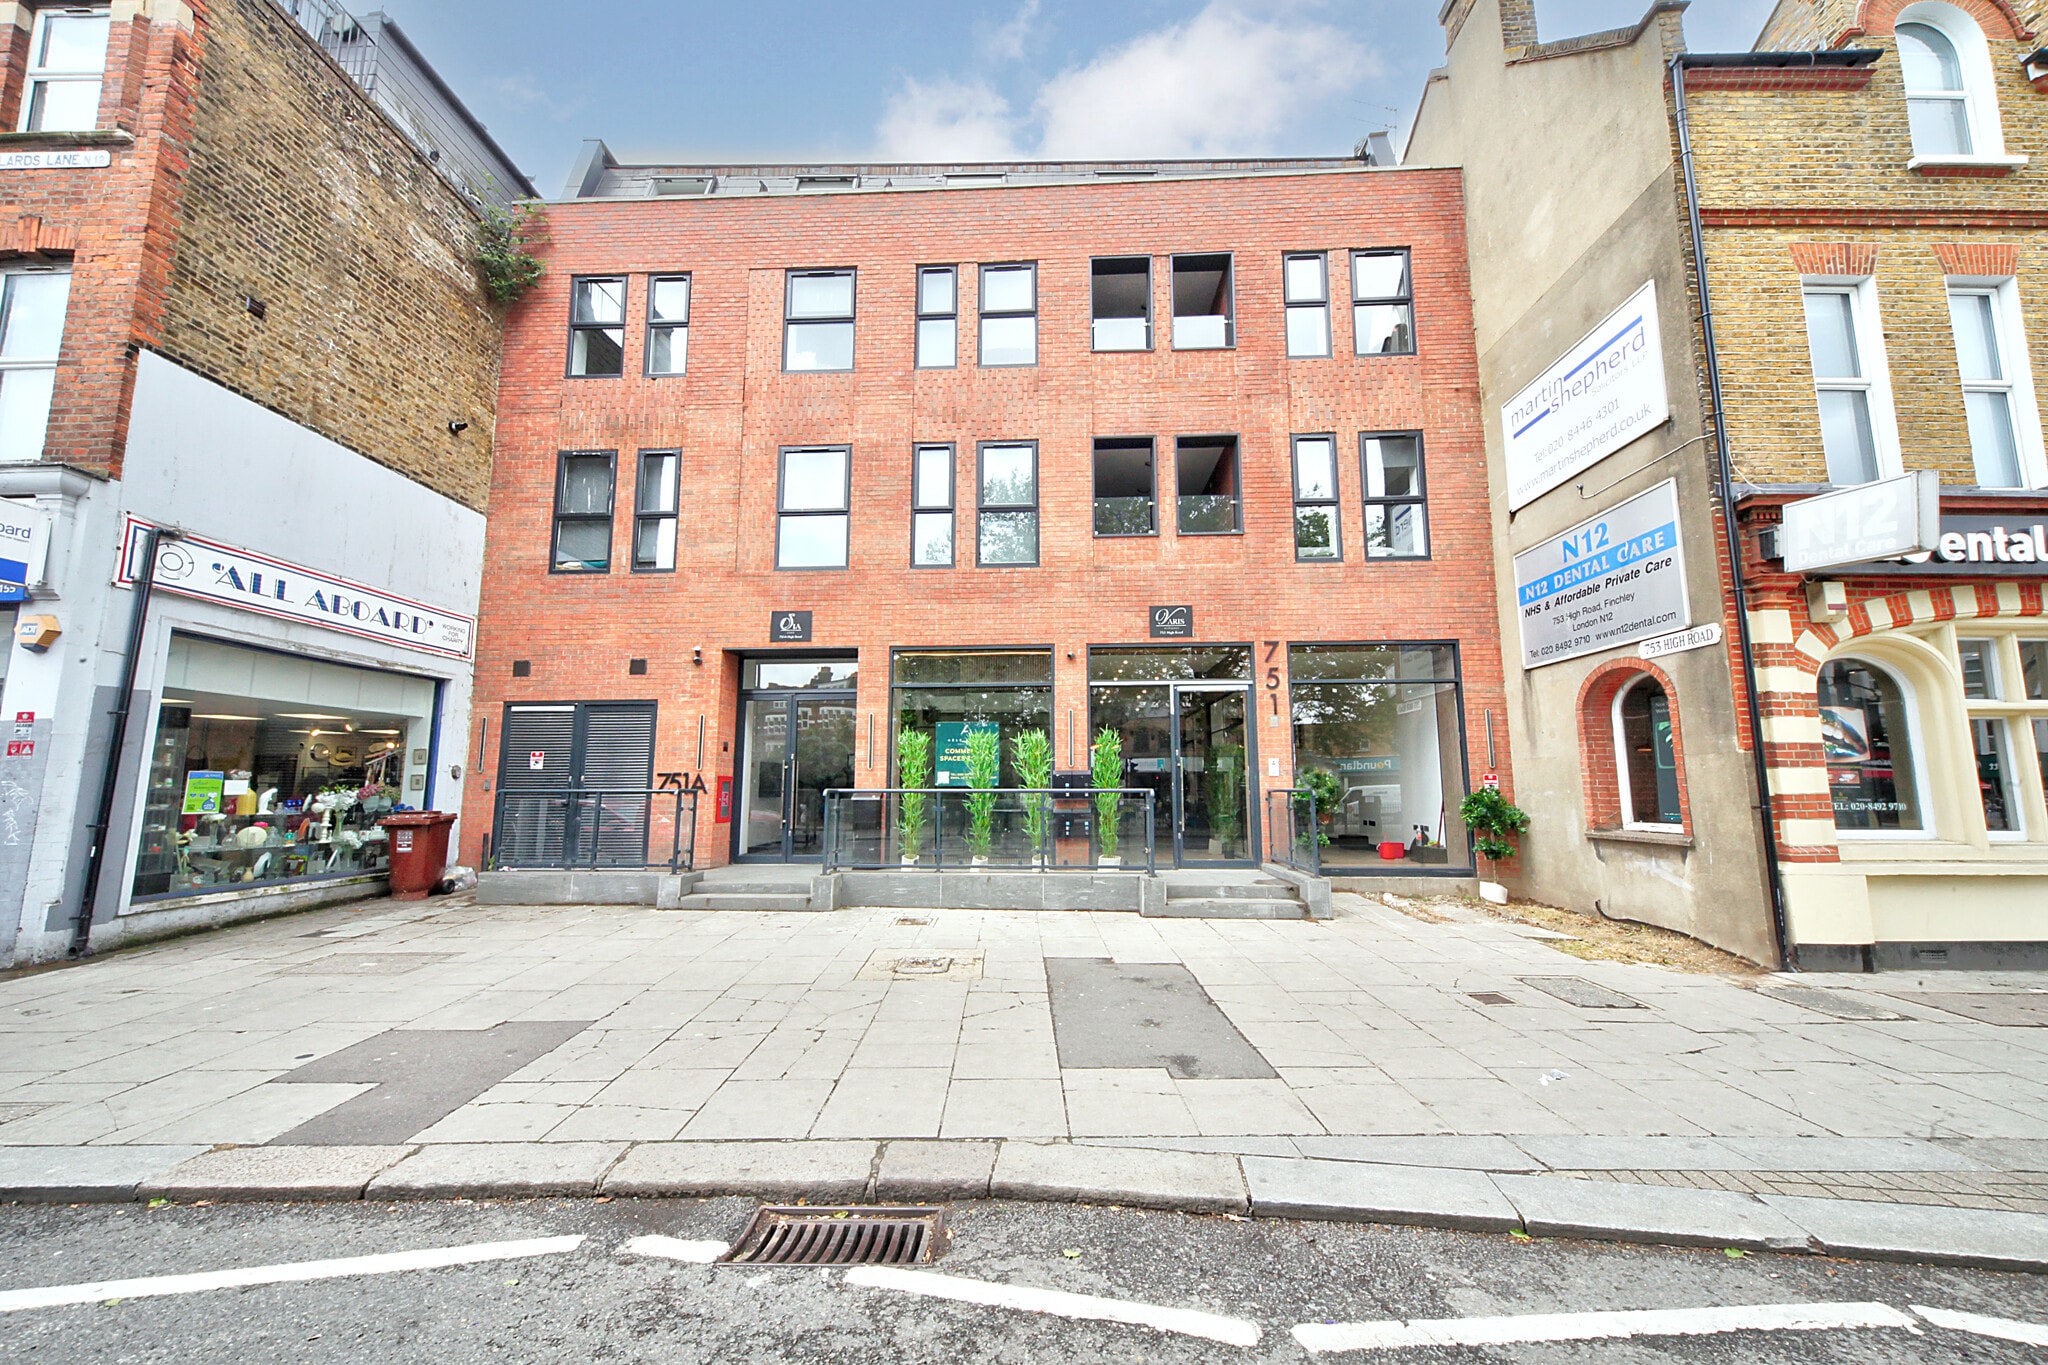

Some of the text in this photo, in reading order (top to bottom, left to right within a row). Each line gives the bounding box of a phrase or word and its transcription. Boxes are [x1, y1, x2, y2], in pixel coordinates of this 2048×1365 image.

[46, 154, 80, 166] LANE
[1551, 326, 1645, 414] shepherd
[1511, 377, 1562, 427] martin
[1567, 416, 1593, 442] 8446
[1596, 398, 1620, 421] 4301
[1517, 403, 1652, 496] www.martinshepherd.co.uk
[1799, 490, 1898, 549] N12
[1562, 522, 1609, 563] N12
[1799, 537, 1897, 564] Dental Care
[1900, 524, 2048, 564] ental
[1525, 531, 1665, 600] N12 DENTAL CARE
[1525, 604, 1541, 618] NHS
[1554, 583, 1601, 608] Affordable
[1605, 569, 1641, 589] Private
[1645, 557, 1672, 574] Care
[1604, 592, 1635, 608] Finchley
[22, 624, 37, 634] ADT
[1541, 645, 1553, 656] 020
[1555, 640, 1572, 652] 8492
[1574, 635, 1590, 647] 9710
[1595, 611, 1677, 641] www.n12dental.com
[1573, 612, 1614, 632] London N12
[1644, 628, 1714, 655] 753 HIGH ROAD
[657, 772, 708, 794] 751A
[1850, 802, 1887, 811] 020-8492
